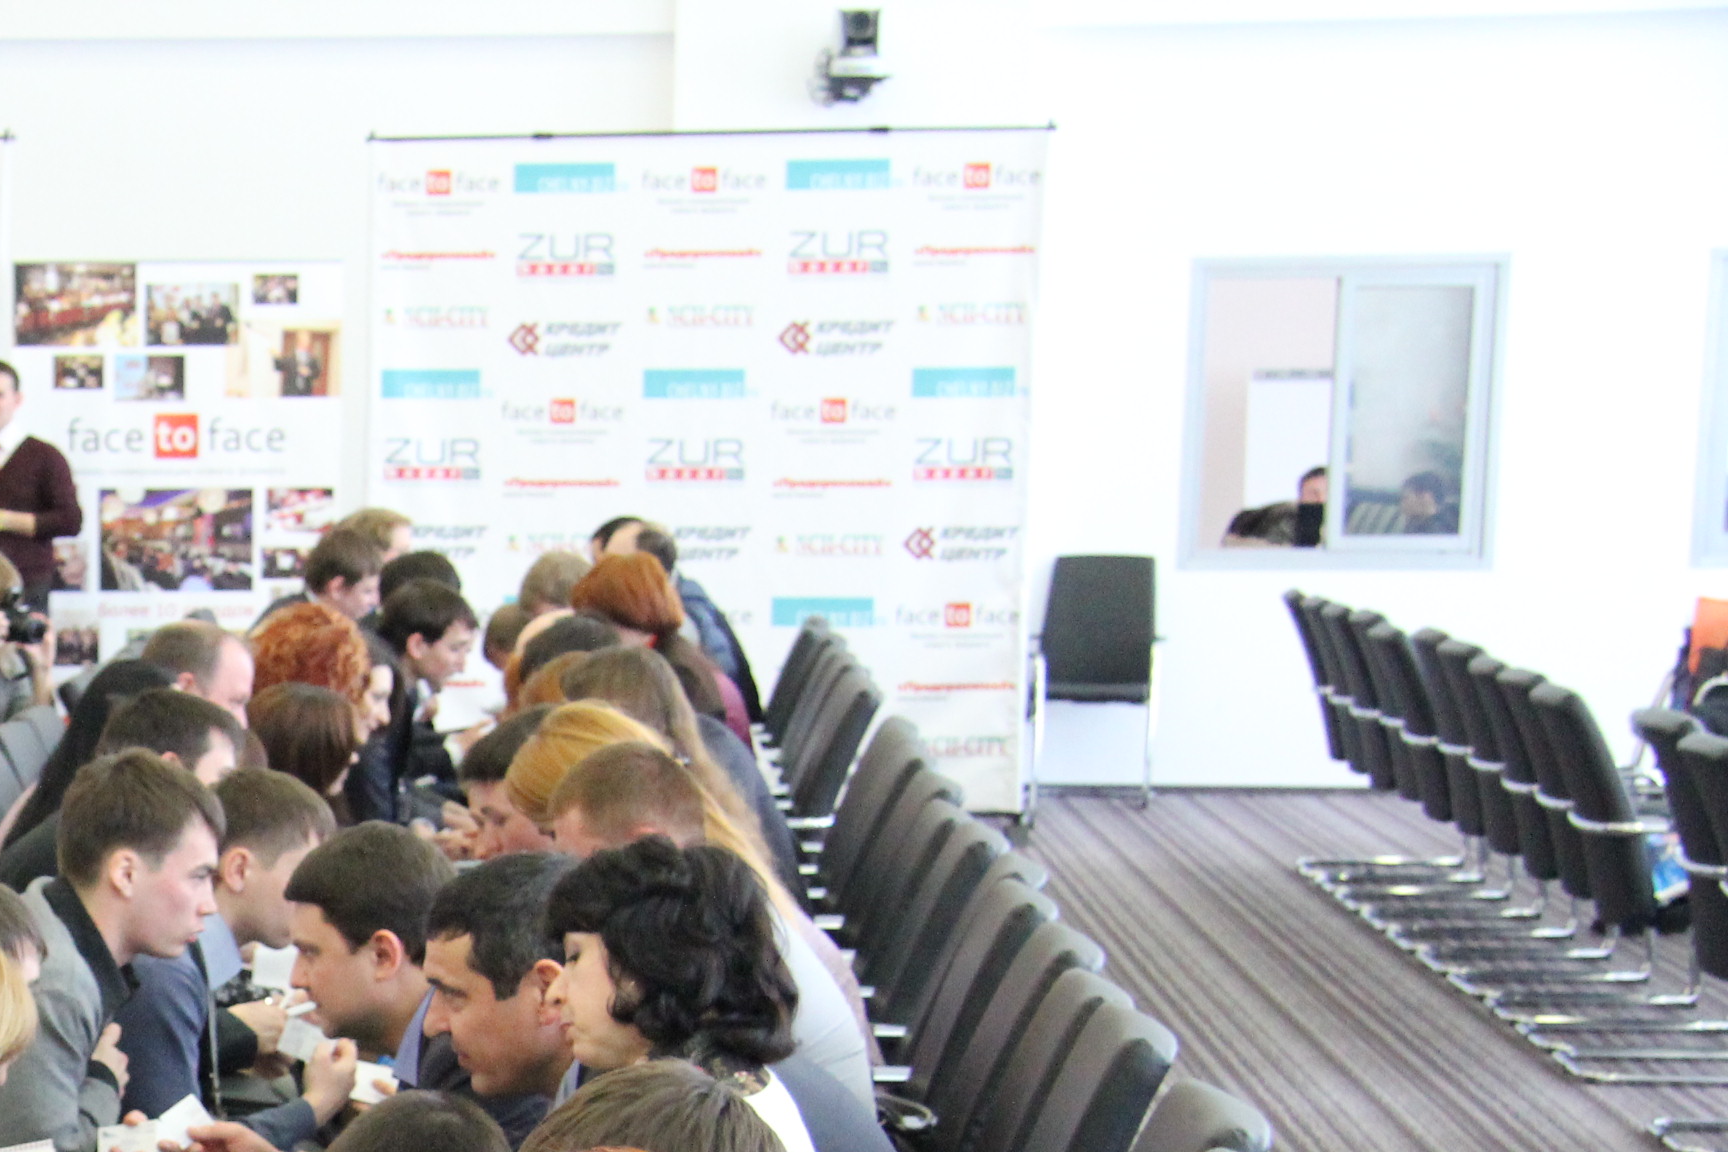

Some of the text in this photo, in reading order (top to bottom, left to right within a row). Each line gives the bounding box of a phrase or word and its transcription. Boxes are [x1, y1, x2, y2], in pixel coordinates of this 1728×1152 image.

[377, 172, 421, 193] face
[456, 170, 501, 192] face
[641, 168, 687, 191] face
[721, 168, 767, 190] face
[912, 165, 959, 187] face
[995, 165, 1042, 186] face
[516, 232, 616, 262] ZUR
[787, 229, 890, 259] ZUR
[501, 400, 546, 421] face
[579, 400, 625, 421] face
[770, 399, 816, 422] face
[851, 399, 898, 420] face
[67, 415, 287, 454] face to face
[383, 436, 481, 466] ZUR
[646, 436, 745, 466] ZUR
[914, 436, 1014, 466] ZUR
[895, 605, 941, 626] face
[976, 603, 1022, 626] face
